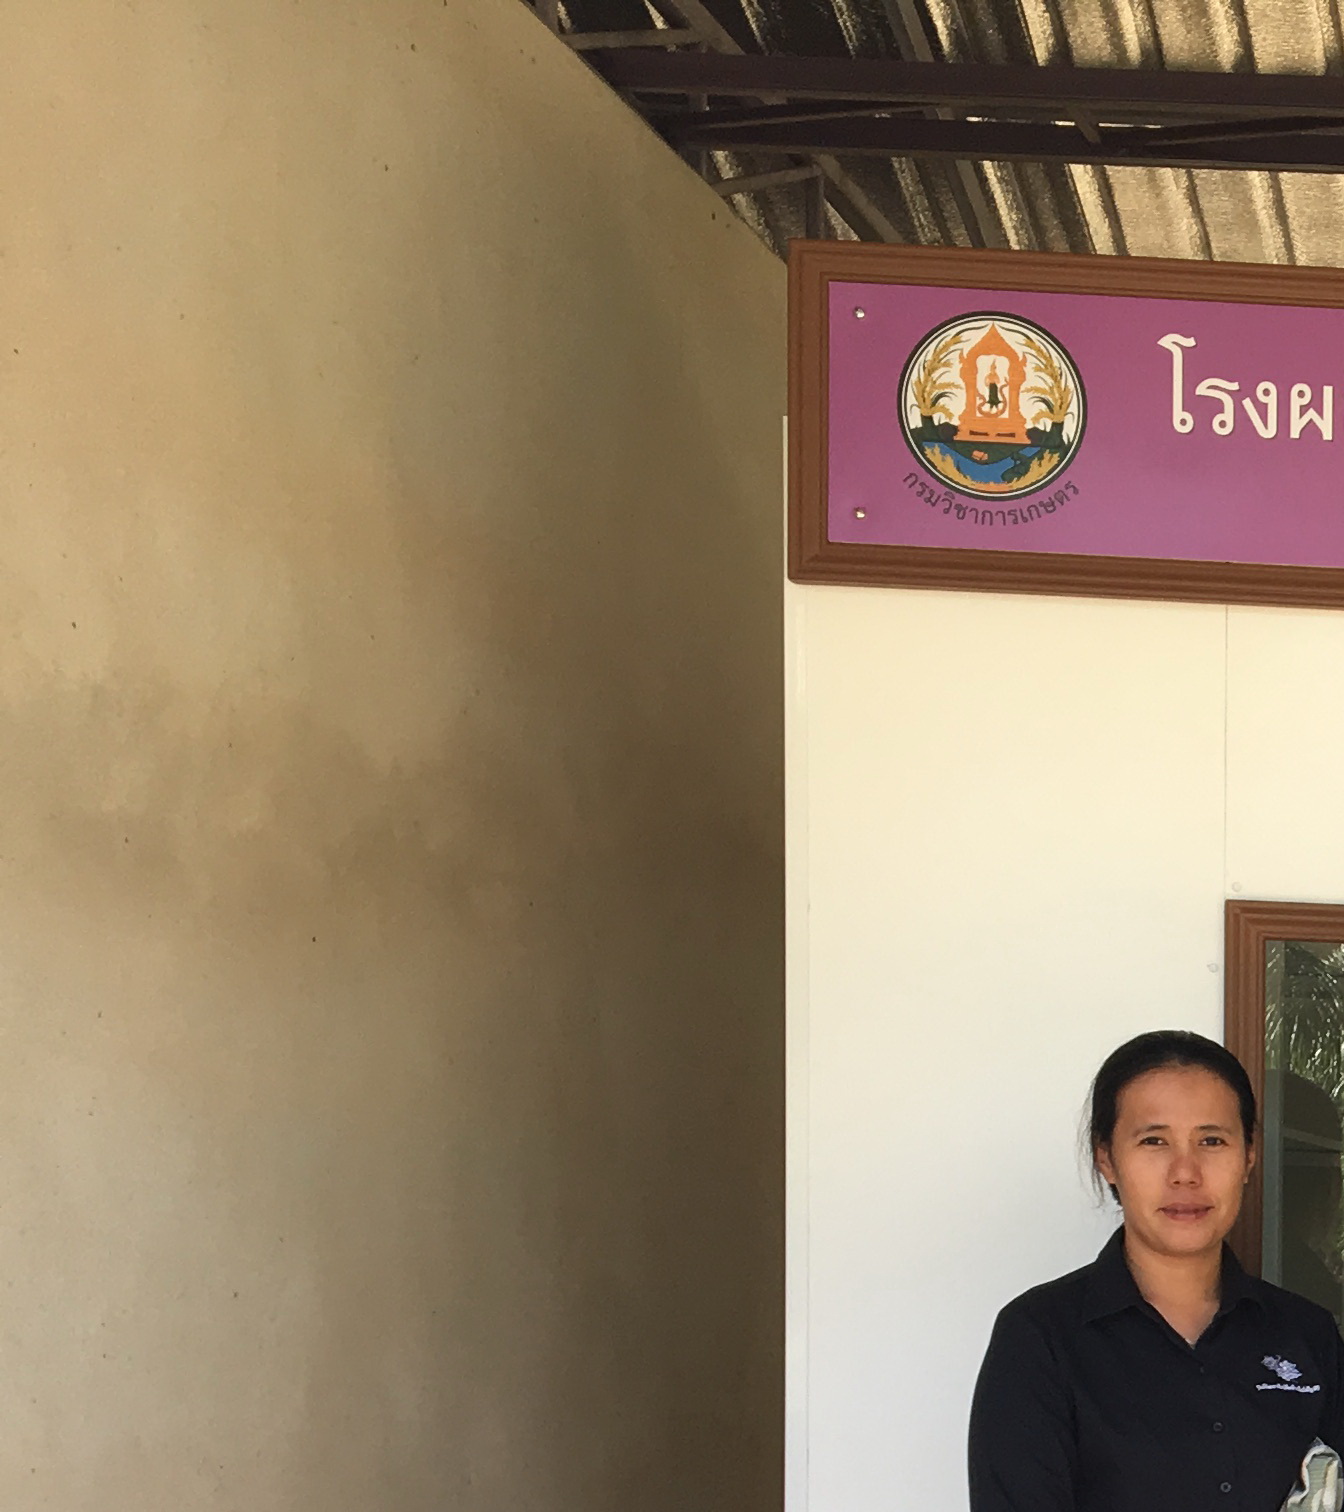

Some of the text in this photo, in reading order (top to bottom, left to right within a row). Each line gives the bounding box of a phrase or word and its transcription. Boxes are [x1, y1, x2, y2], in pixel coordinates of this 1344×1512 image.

[903, 471, 1079, 526] กรมวิชาการเกษตร
